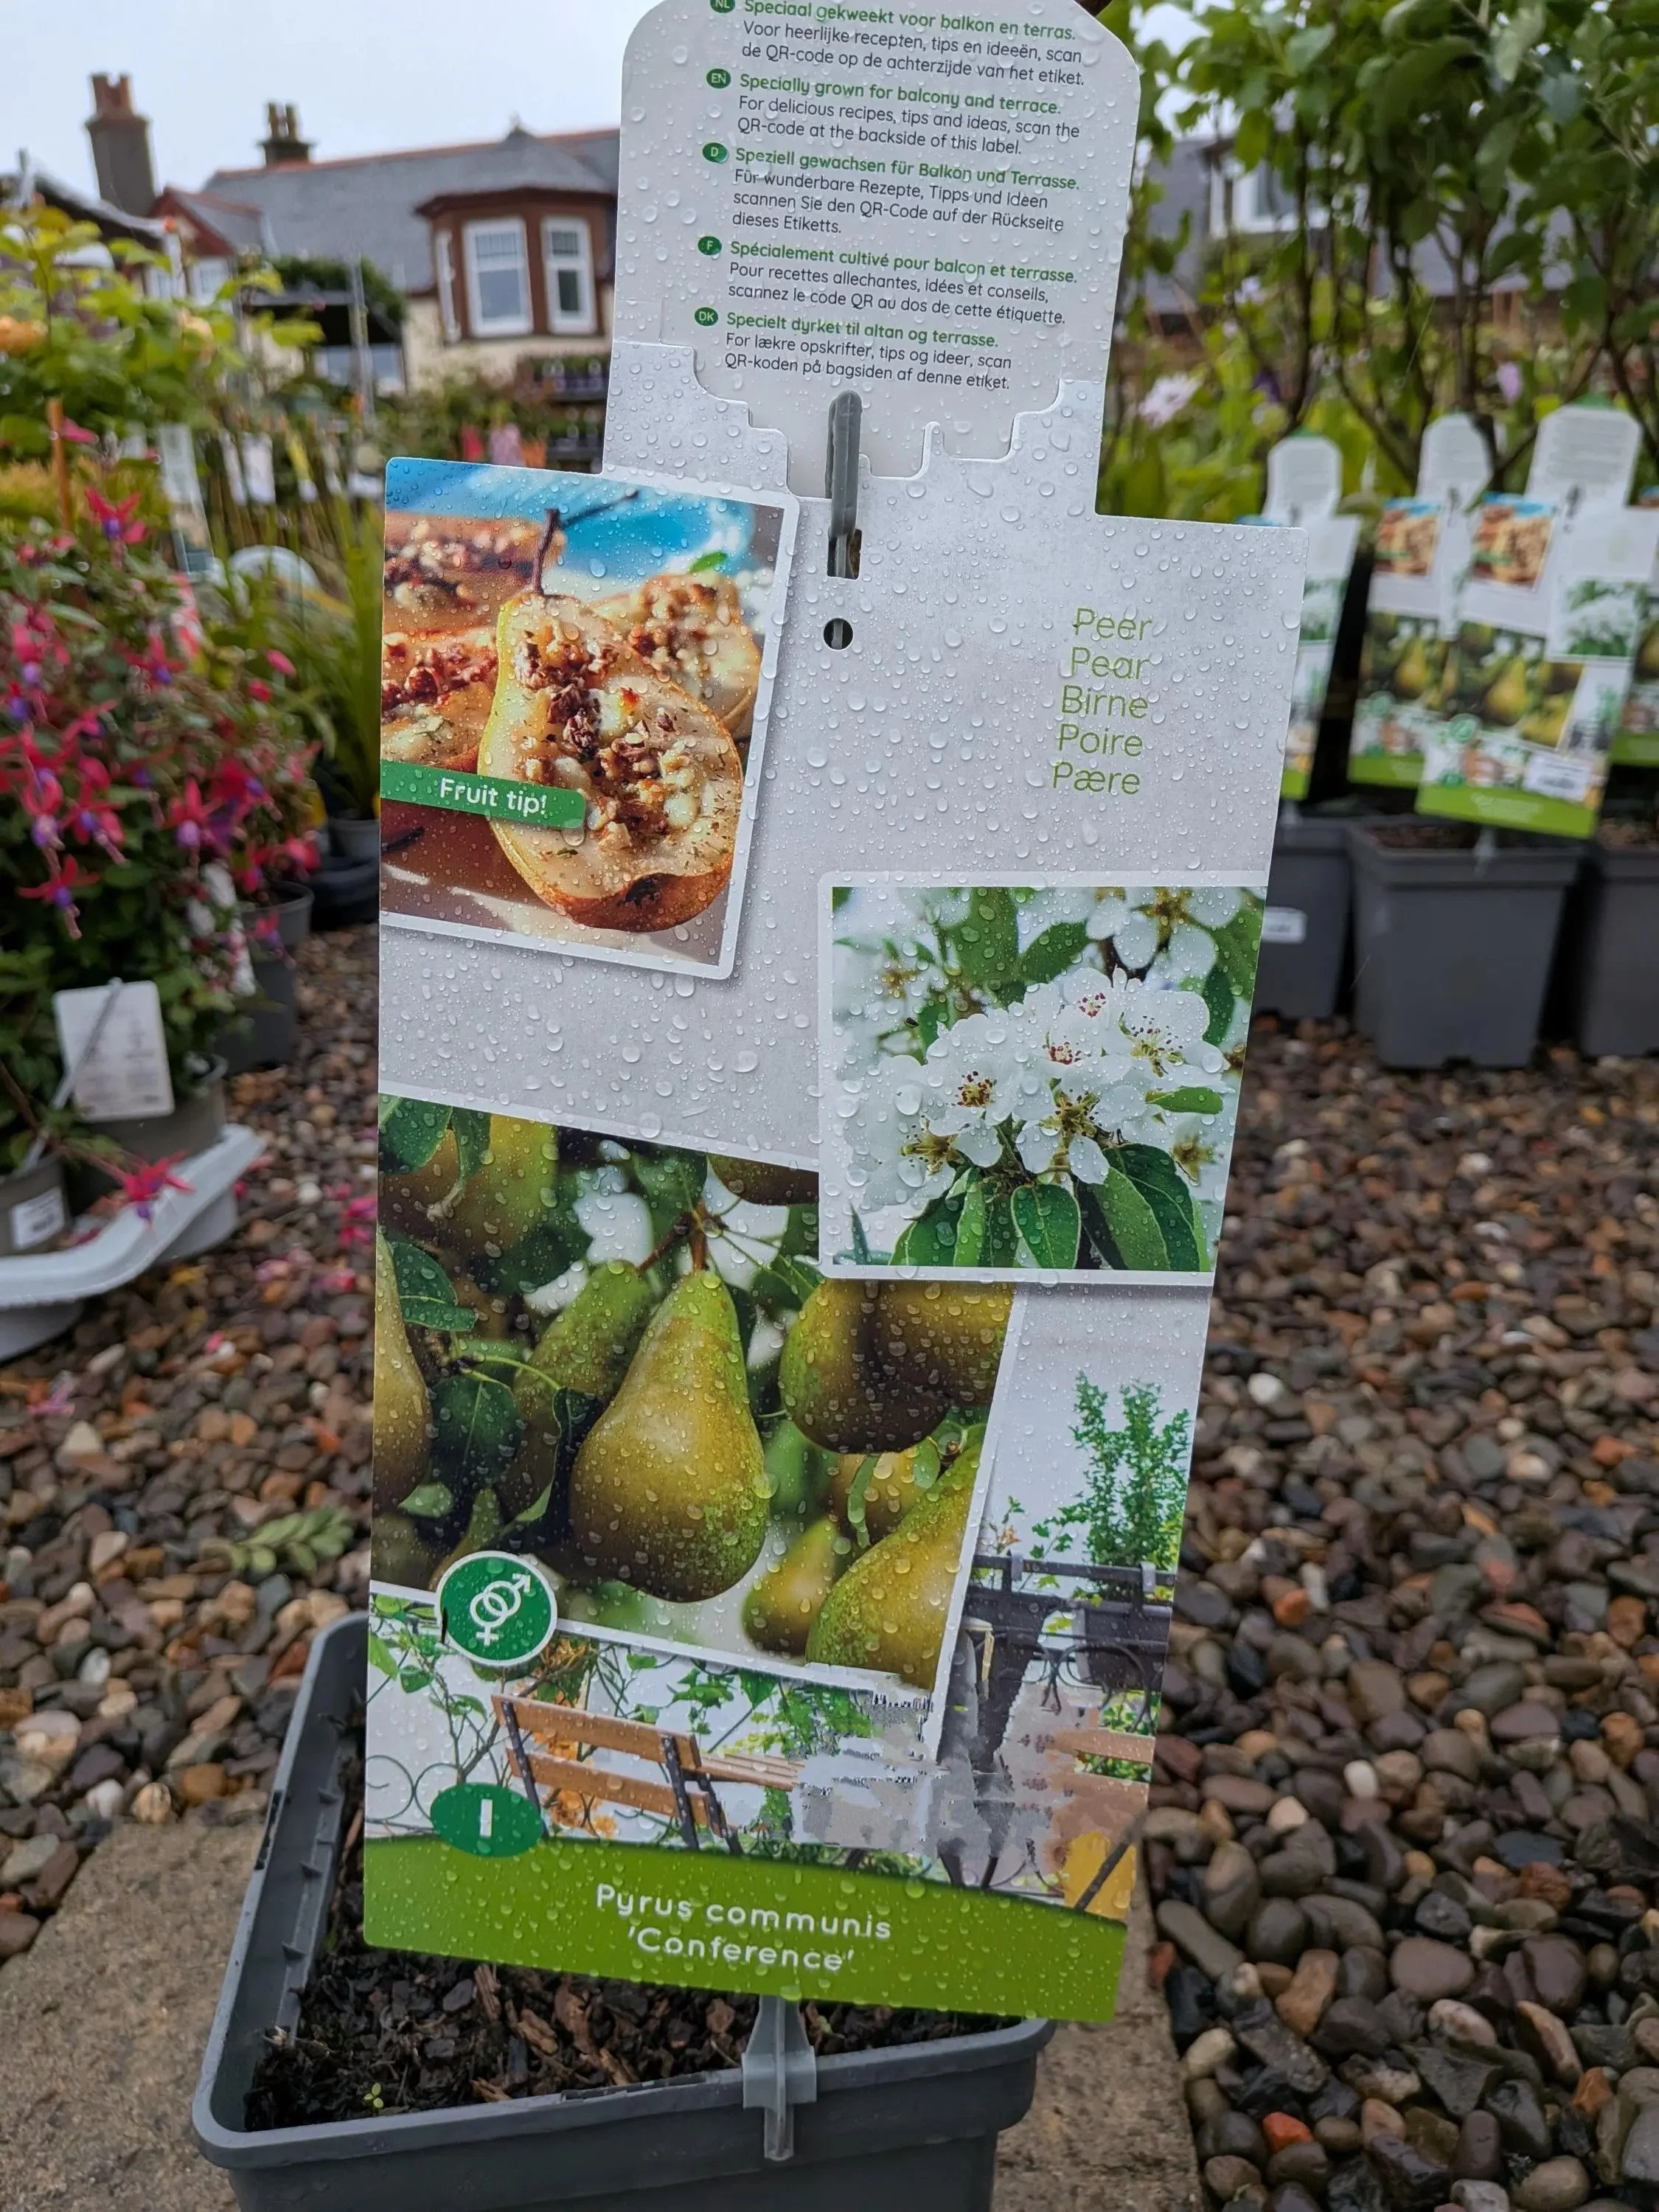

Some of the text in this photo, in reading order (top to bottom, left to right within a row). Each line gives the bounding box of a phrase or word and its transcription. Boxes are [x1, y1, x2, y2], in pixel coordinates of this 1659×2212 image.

[745, 0, 1076, 40] Speciaal gekweekt voor balkon en terras.
[743, 20, 1081, 63] Voor heerlijke recepten, tips en ideeën, scan
[712, 74, 726, 83] EN
[742, 43, 1084, 85] de QR-code op de achterzijde van het etiket.
[740, 74, 1061, 114] Specially grown for balcony and terrace.
[738, 117, 1021, 154] QR-code at the backside of this label.
[740, 96, 1079, 138] For delicious recipes, tips and ideas, scan the
[711, 147, 718, 156] D
[736, 147, 1079, 189] Speziell gewachsen für Balkon und Terrasse.
[735, 169, 1048, 208] Für wunderbare Rezepte, Tipps und Ideen
[733, 212, 841, 233] dieses Etiketts.
[734, 193, 1063, 231] scannen Sie den QR-Code auf der Rückseite
[707, 241, 714, 250] F
[731, 241, 1077, 282] Spécialement cultivé pour balcon et terrasse.
[730, 262, 1048, 303] Pour recettes allechantes, idées et conseils,
[699, 312, 714, 321] DK
[728, 286, 1065, 324] scannez le code QR au dos de cette étiquette.
[727, 313, 998, 347] Specielt dyrket til altan og terrasse.
[726, 333, 1012, 369] For lækre opskrifter, tips og ideer, scan
[726, 353, 1009, 389] QR-koden på bagsiden af denne etiket.
[1073, 608, 1152, 640] Peer
[1071, 647, 1150, 679] Pear
[1061, 684, 1148, 718] Birne
[1059, 723, 1142, 757] Poire
[1053, 762, 1140, 794] Pære
[440, 777, 547, 817] Fruit tip!
[597, 1883, 891, 1940] Pyrus communis
[627, 1926, 855, 1971] 'Conference'
